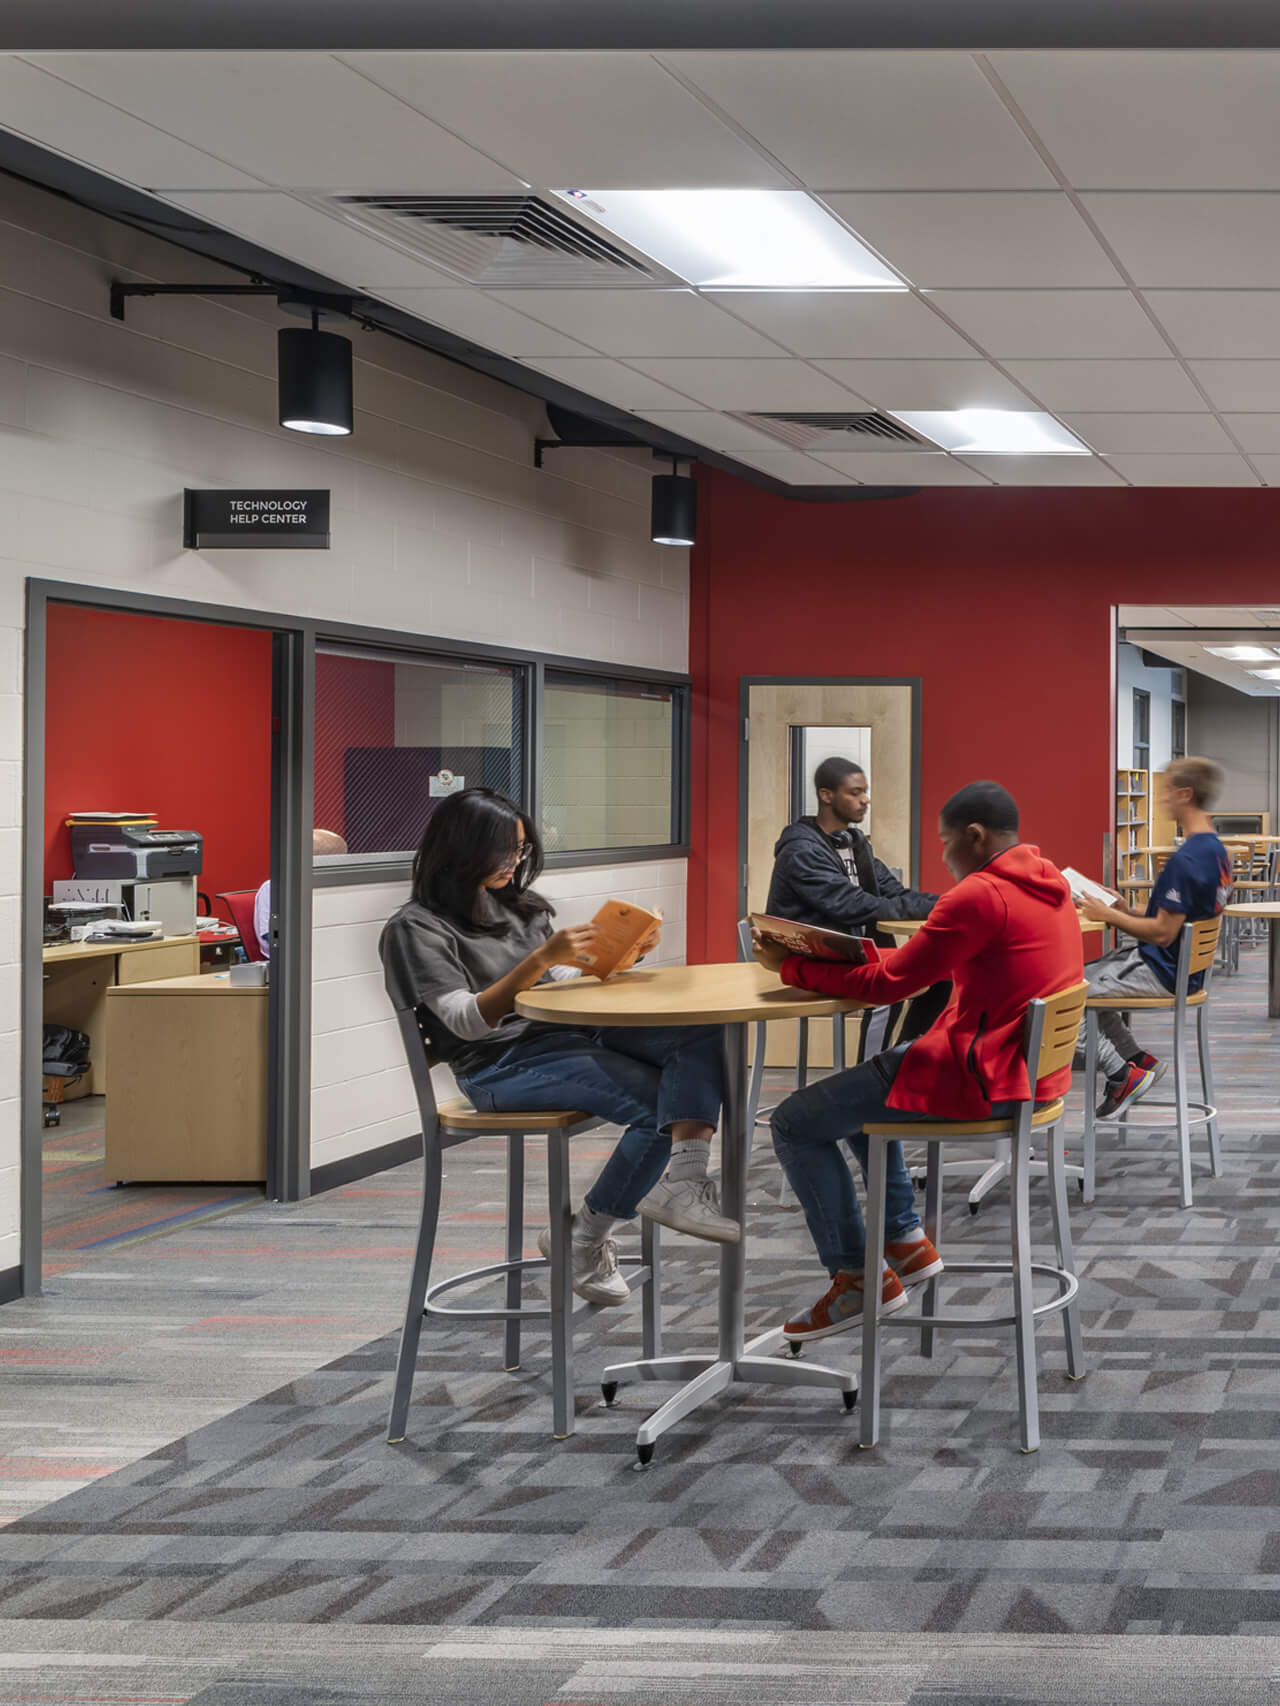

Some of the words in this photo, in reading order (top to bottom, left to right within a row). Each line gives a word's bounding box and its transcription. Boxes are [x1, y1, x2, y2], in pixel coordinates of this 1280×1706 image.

[229, 500, 308, 511] TECHNOLOGY
[229, 514, 259, 524] HELP
[261, 514, 307, 524] CENTER
